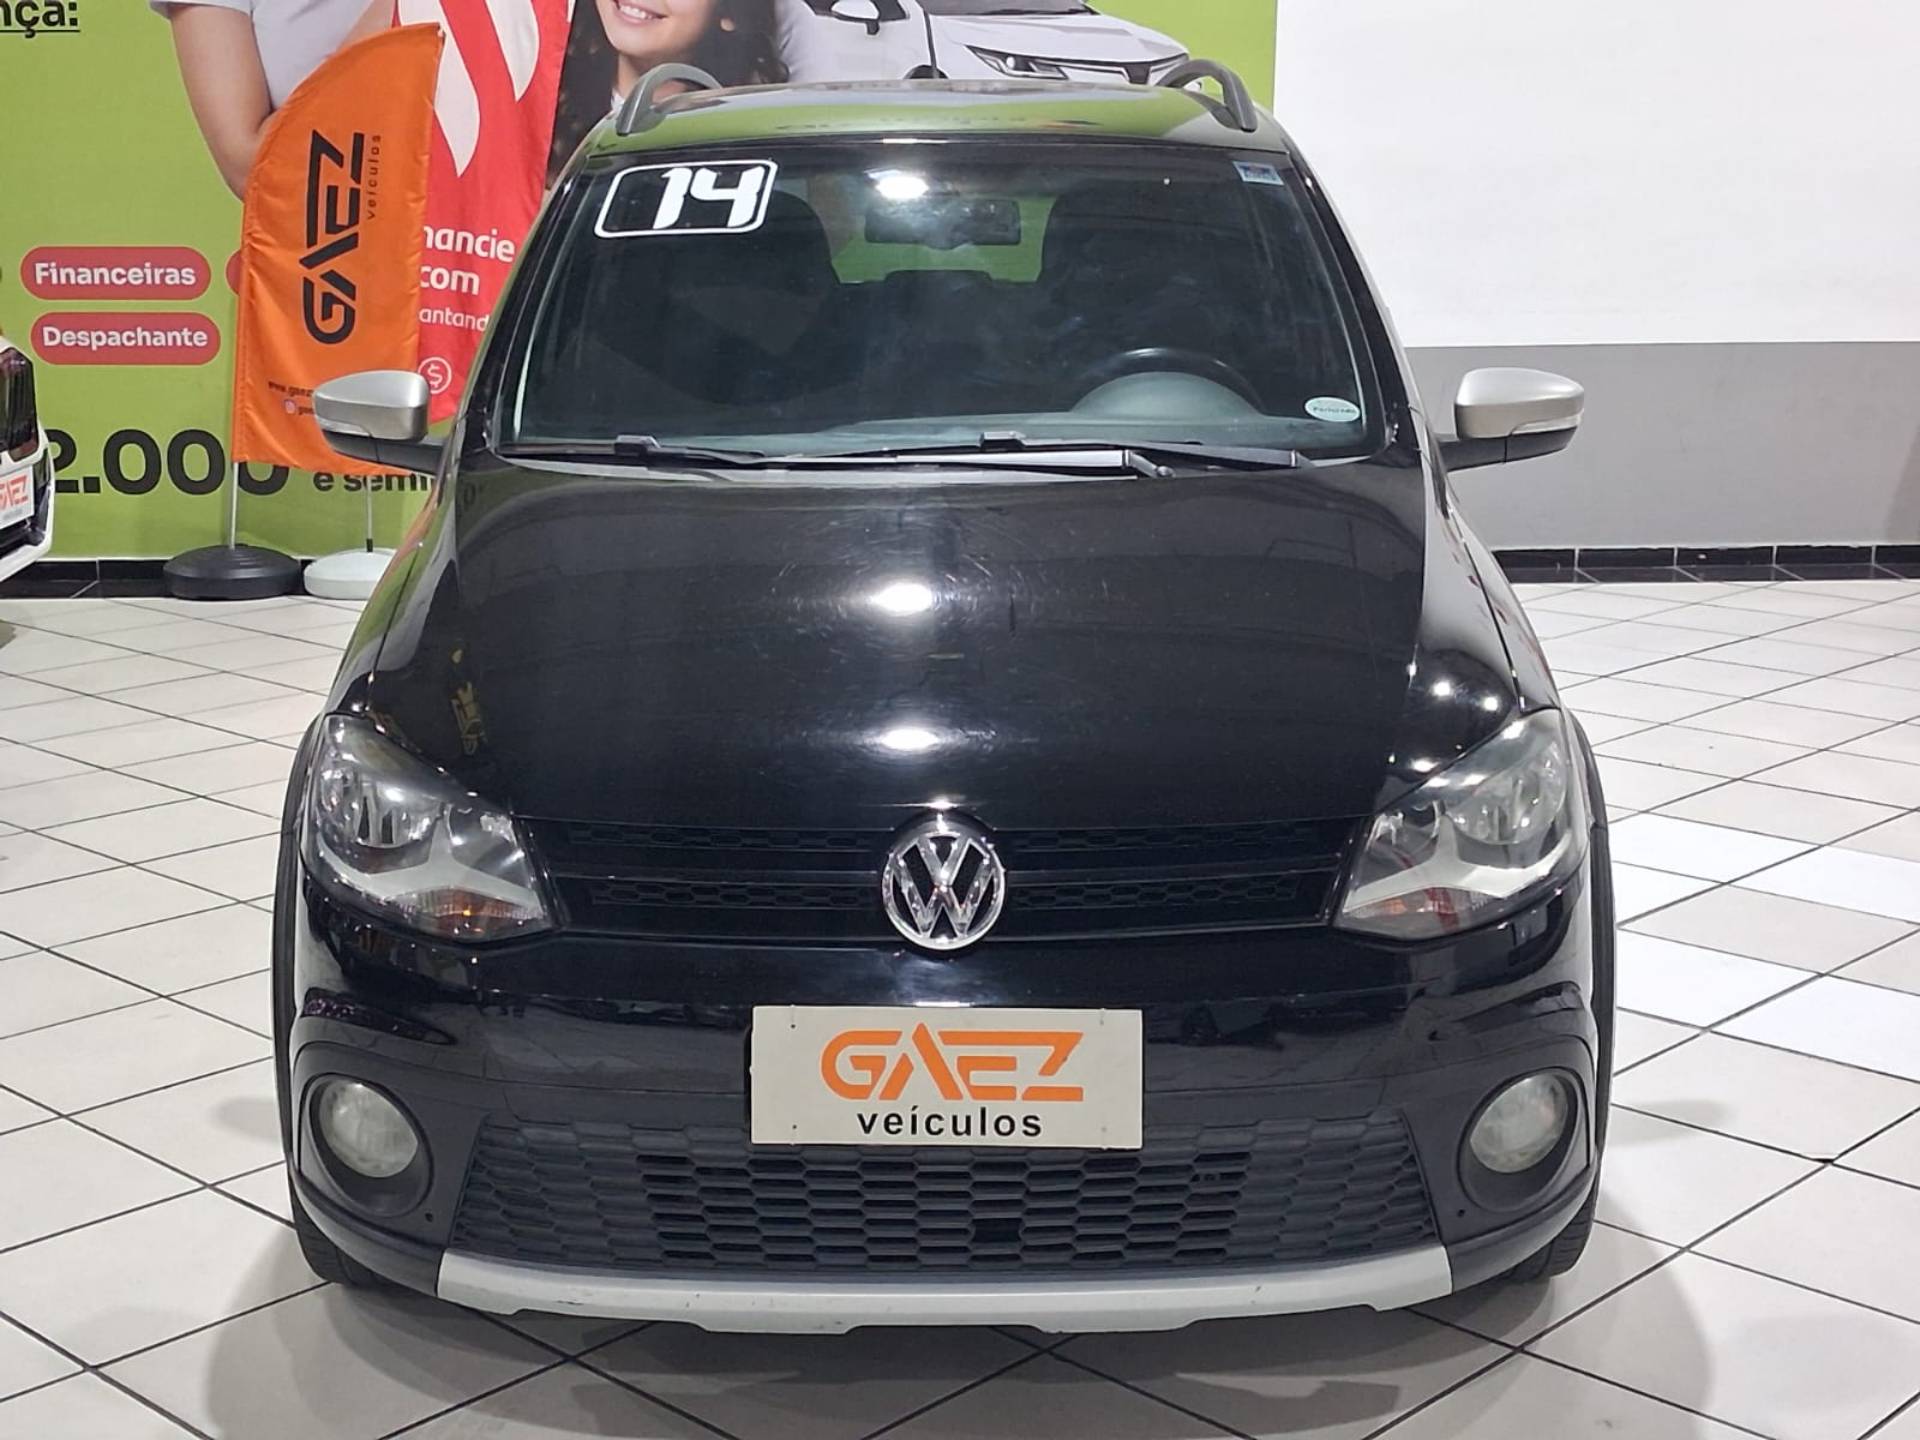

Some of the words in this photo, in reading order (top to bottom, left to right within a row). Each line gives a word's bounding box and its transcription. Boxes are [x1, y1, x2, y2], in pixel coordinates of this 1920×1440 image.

[653, 166, 765, 230] 14
[299, 129, 365, 345] GAEZ
[35, 262, 196, 285] Financeiras
[42, 327, 208, 351] Despachante
[313, 472, 333, 492] e
[820, 1023, 1084, 1101] GAEZ
[856, 1106, 1042, 1137] veículos
